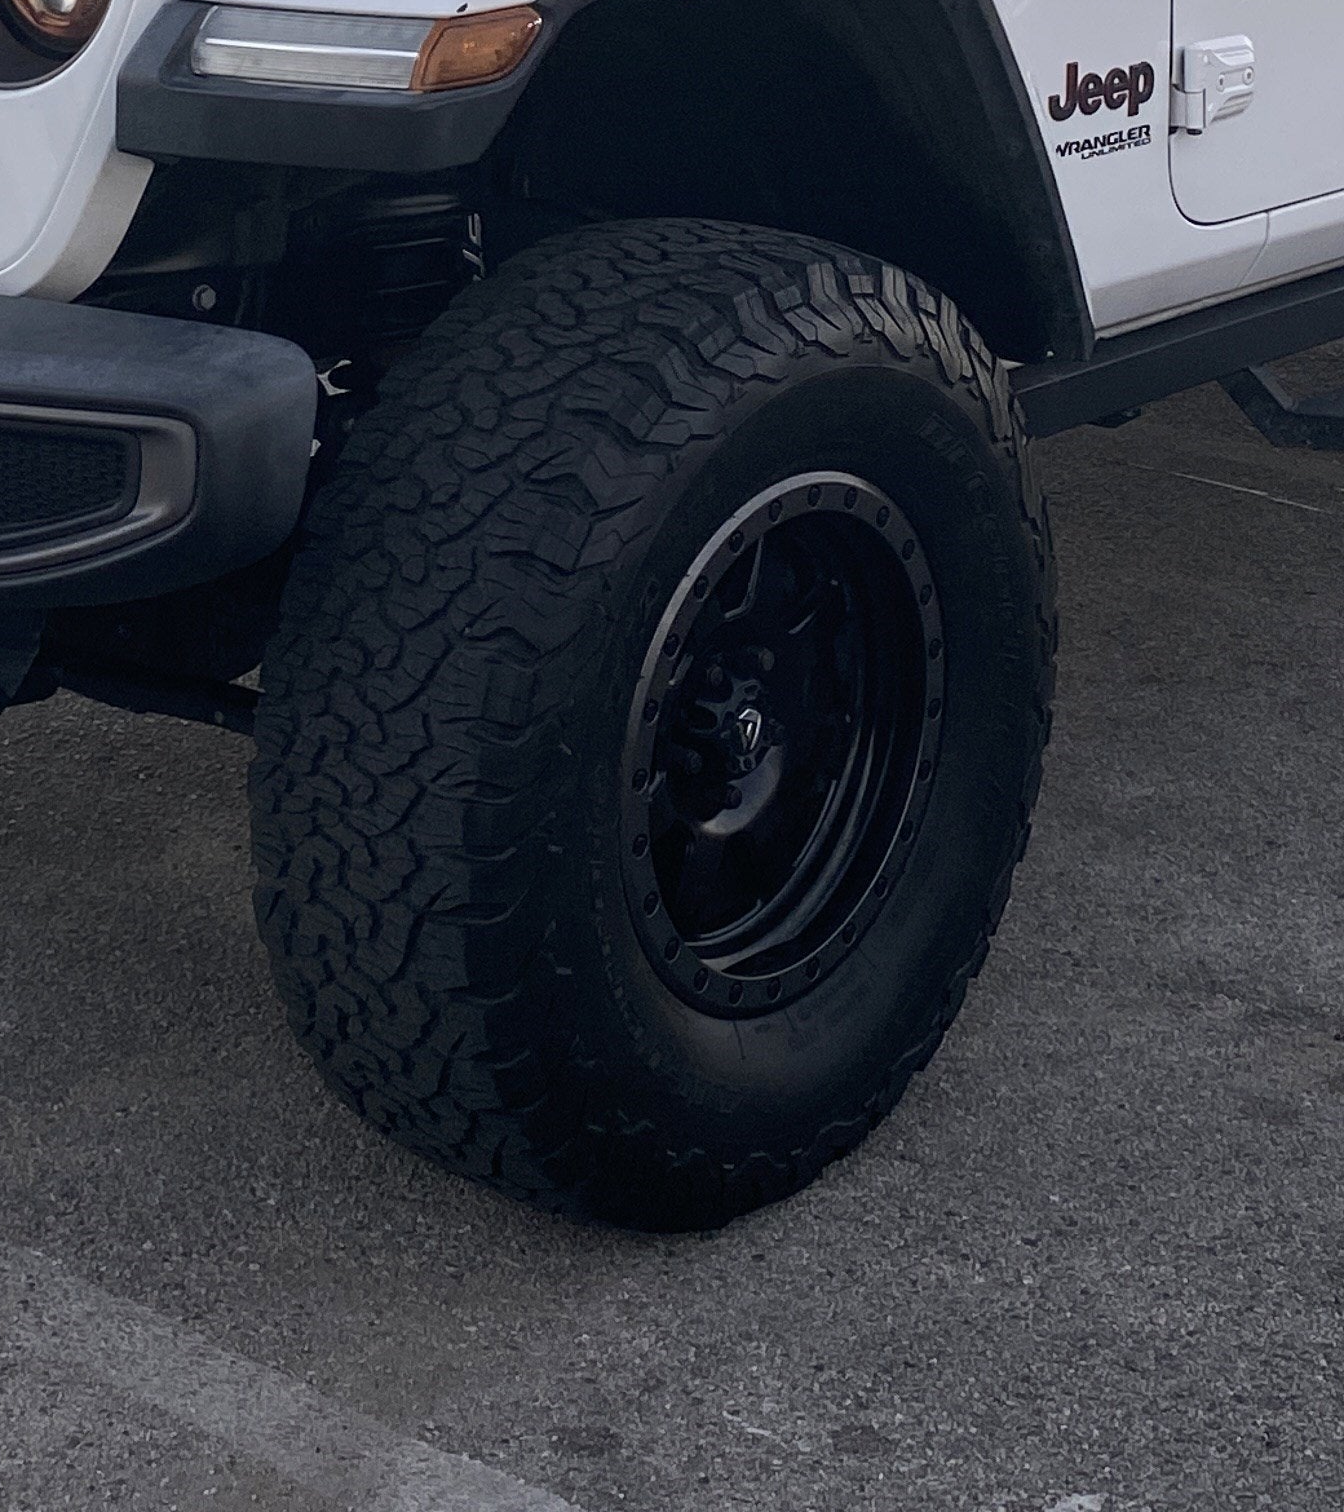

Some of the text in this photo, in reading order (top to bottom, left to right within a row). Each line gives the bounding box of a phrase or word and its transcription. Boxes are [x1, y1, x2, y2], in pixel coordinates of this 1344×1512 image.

[1047, 61, 1155, 122] Jeep
[1056, 124, 1151, 158] WRANGLER
[1081, 138, 1152, 160] UNLIMITED
